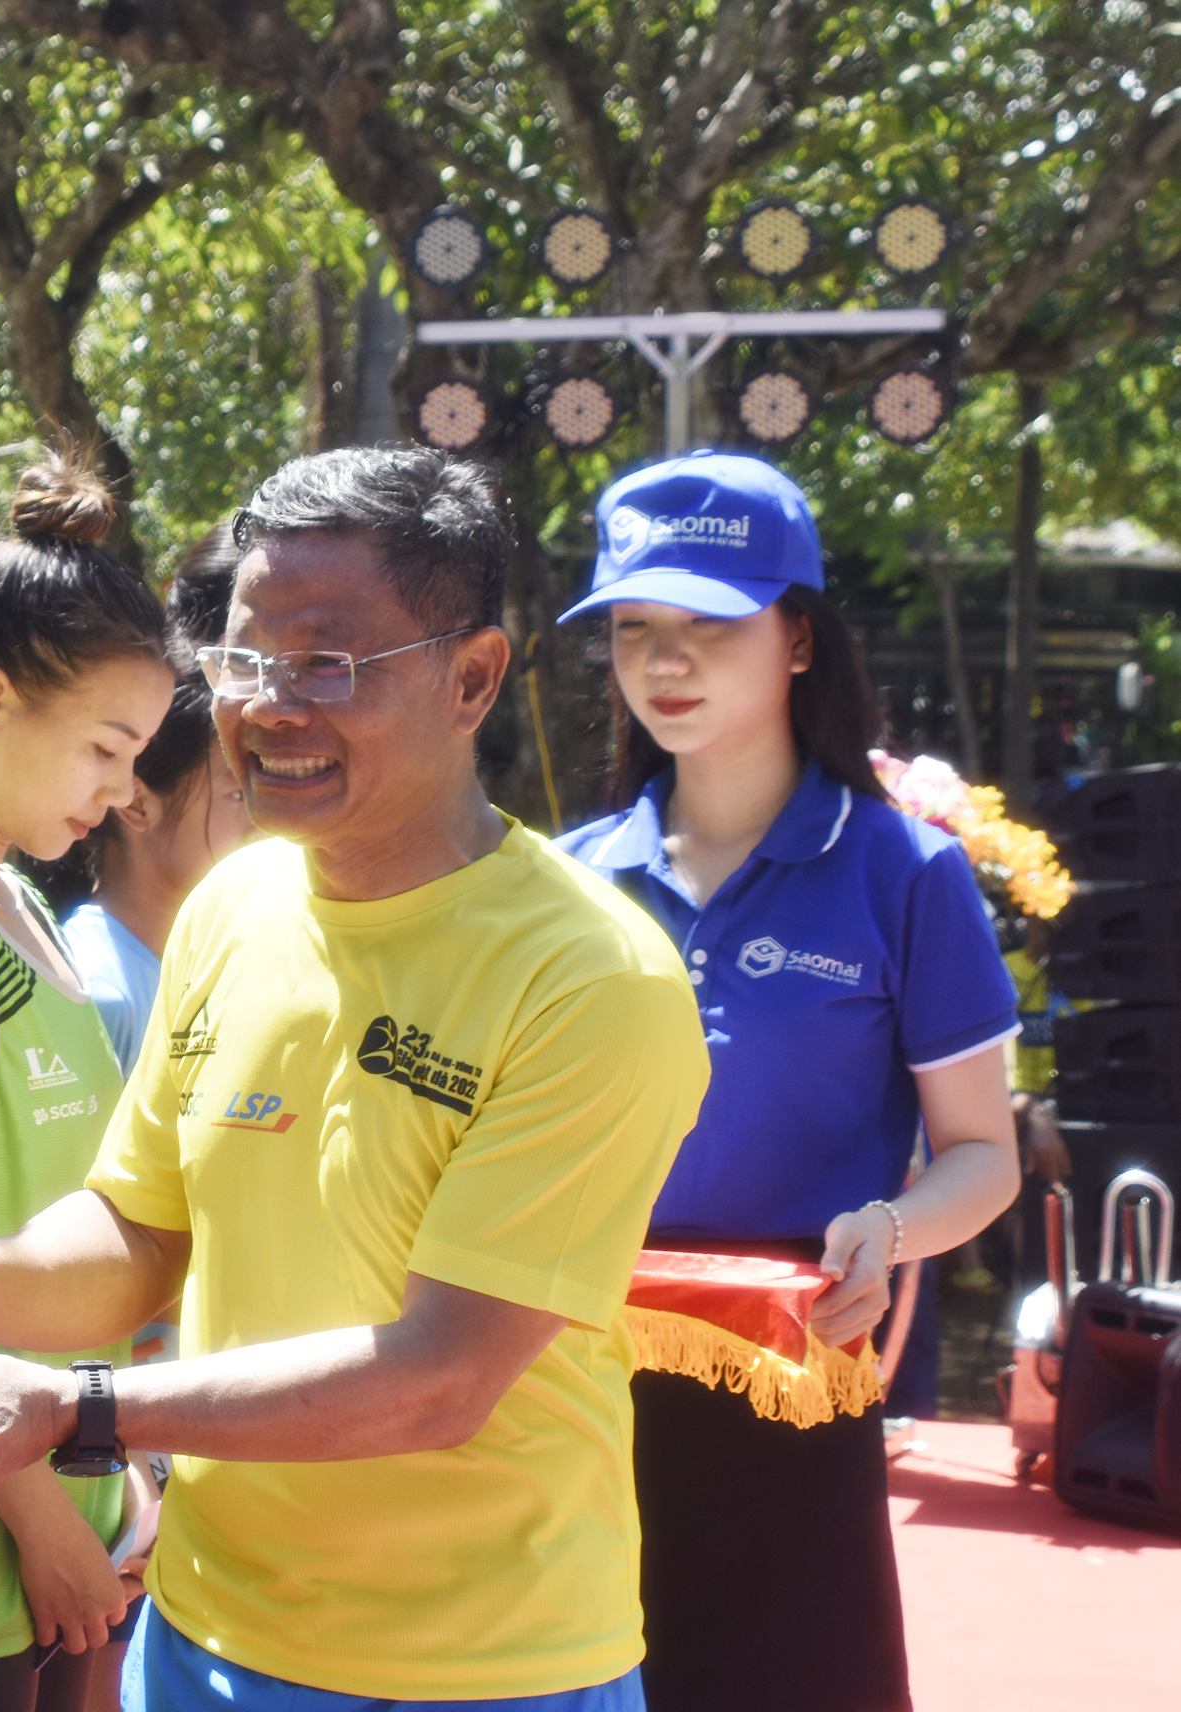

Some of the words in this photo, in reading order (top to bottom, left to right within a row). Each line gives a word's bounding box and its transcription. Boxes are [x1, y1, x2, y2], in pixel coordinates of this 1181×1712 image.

[649, 515, 750, 537] Saomai
[785, 950, 863, 979] Saomai
[399, 1024, 431, 1058] 23
[50, 1100, 84, 1120] SCGC
[224, 1092, 283, 1120] LSP
